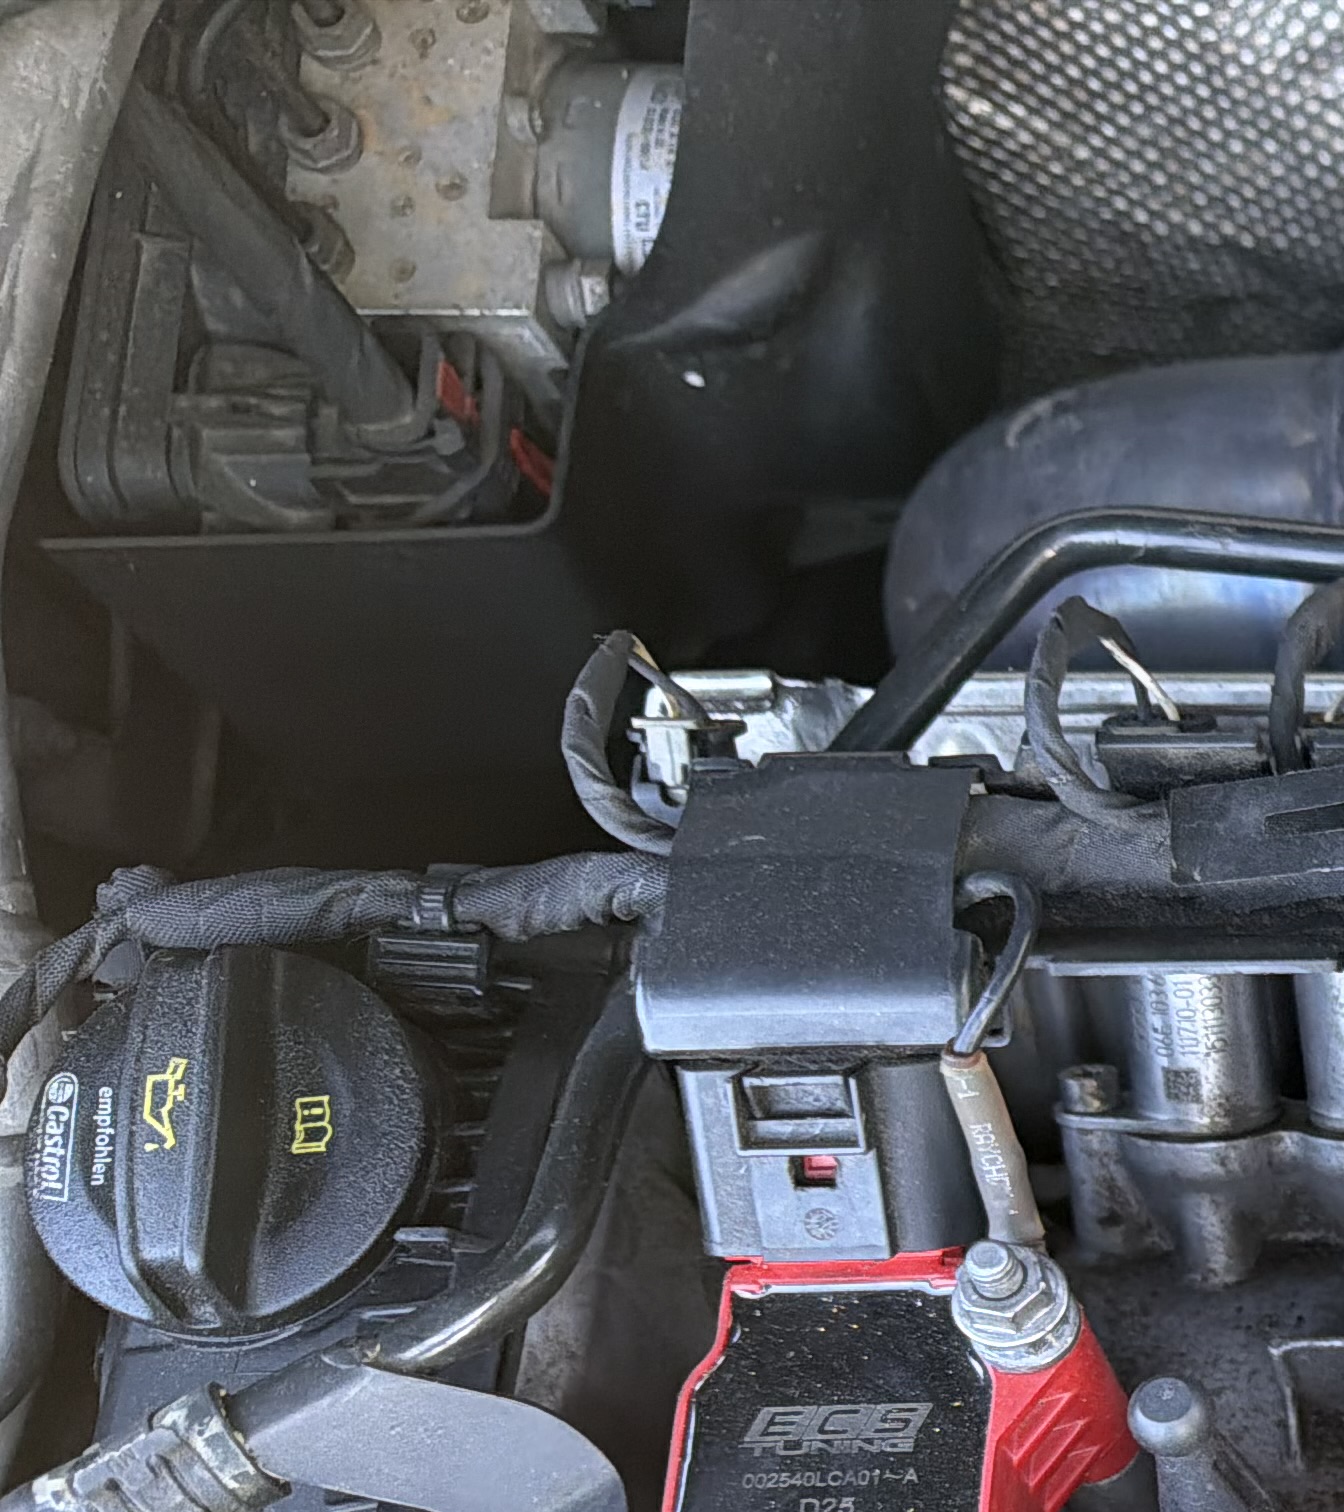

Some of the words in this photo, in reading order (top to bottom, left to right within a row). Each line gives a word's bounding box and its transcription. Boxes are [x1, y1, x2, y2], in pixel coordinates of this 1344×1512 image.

[41, 1105, 70, 1191] Castrol
[91, 1086, 115, 1187] empfohlen
[738, 1440, 917, 1457] TUNING
[742, 1403, 933, 1443] ECS
